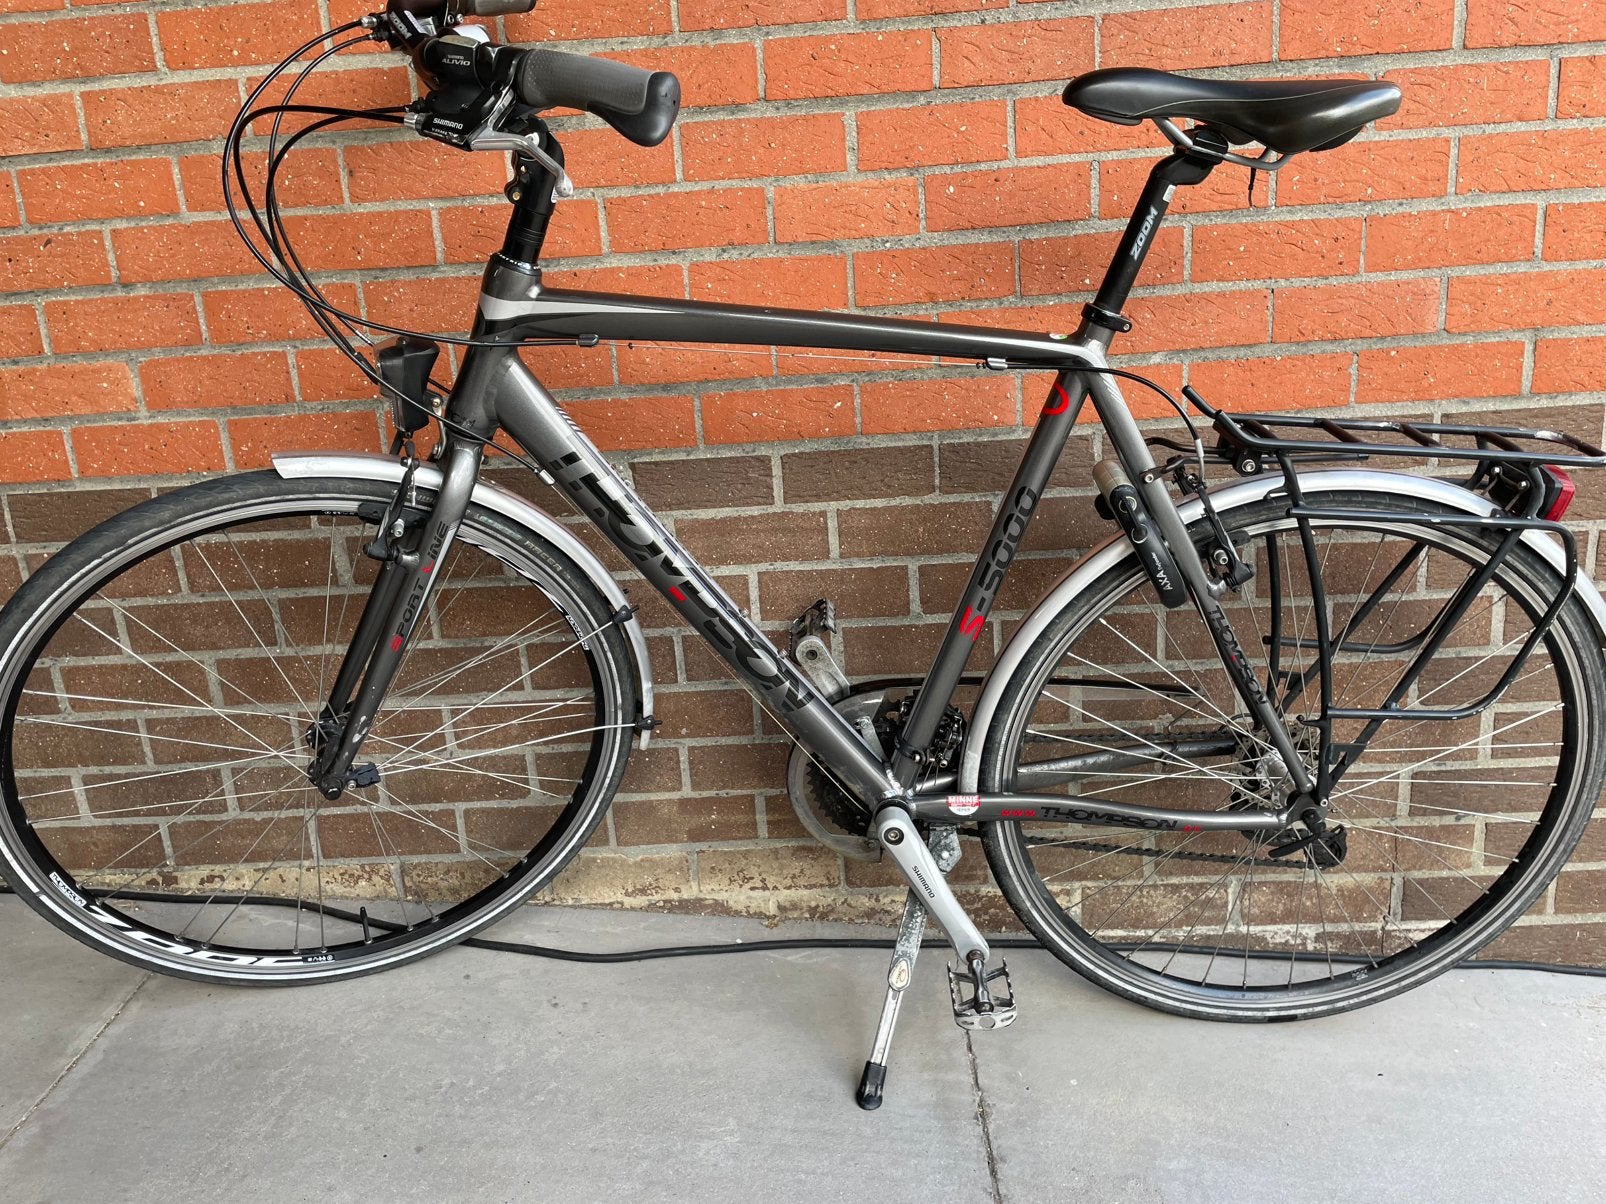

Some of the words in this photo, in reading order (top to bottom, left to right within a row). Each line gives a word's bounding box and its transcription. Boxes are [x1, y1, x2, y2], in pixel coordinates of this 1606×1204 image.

[441, 58, 471, 66] ALIVIO
[432, 116, 464, 130] SHIMANO
[1130, 206, 1159, 261] ZOOM
[549, 445, 816, 714] THOMPSON
[958, 485, 1038, 642] S-5000
[1154, 570, 1174, 592] AXA
[388, 579, 427, 654] SPORT
[1206, 604, 1267, 706] THOMPSON
[1040, 806, 1179, 830] THOMPSON
[911, 865, 935, 899] SHIMANO
